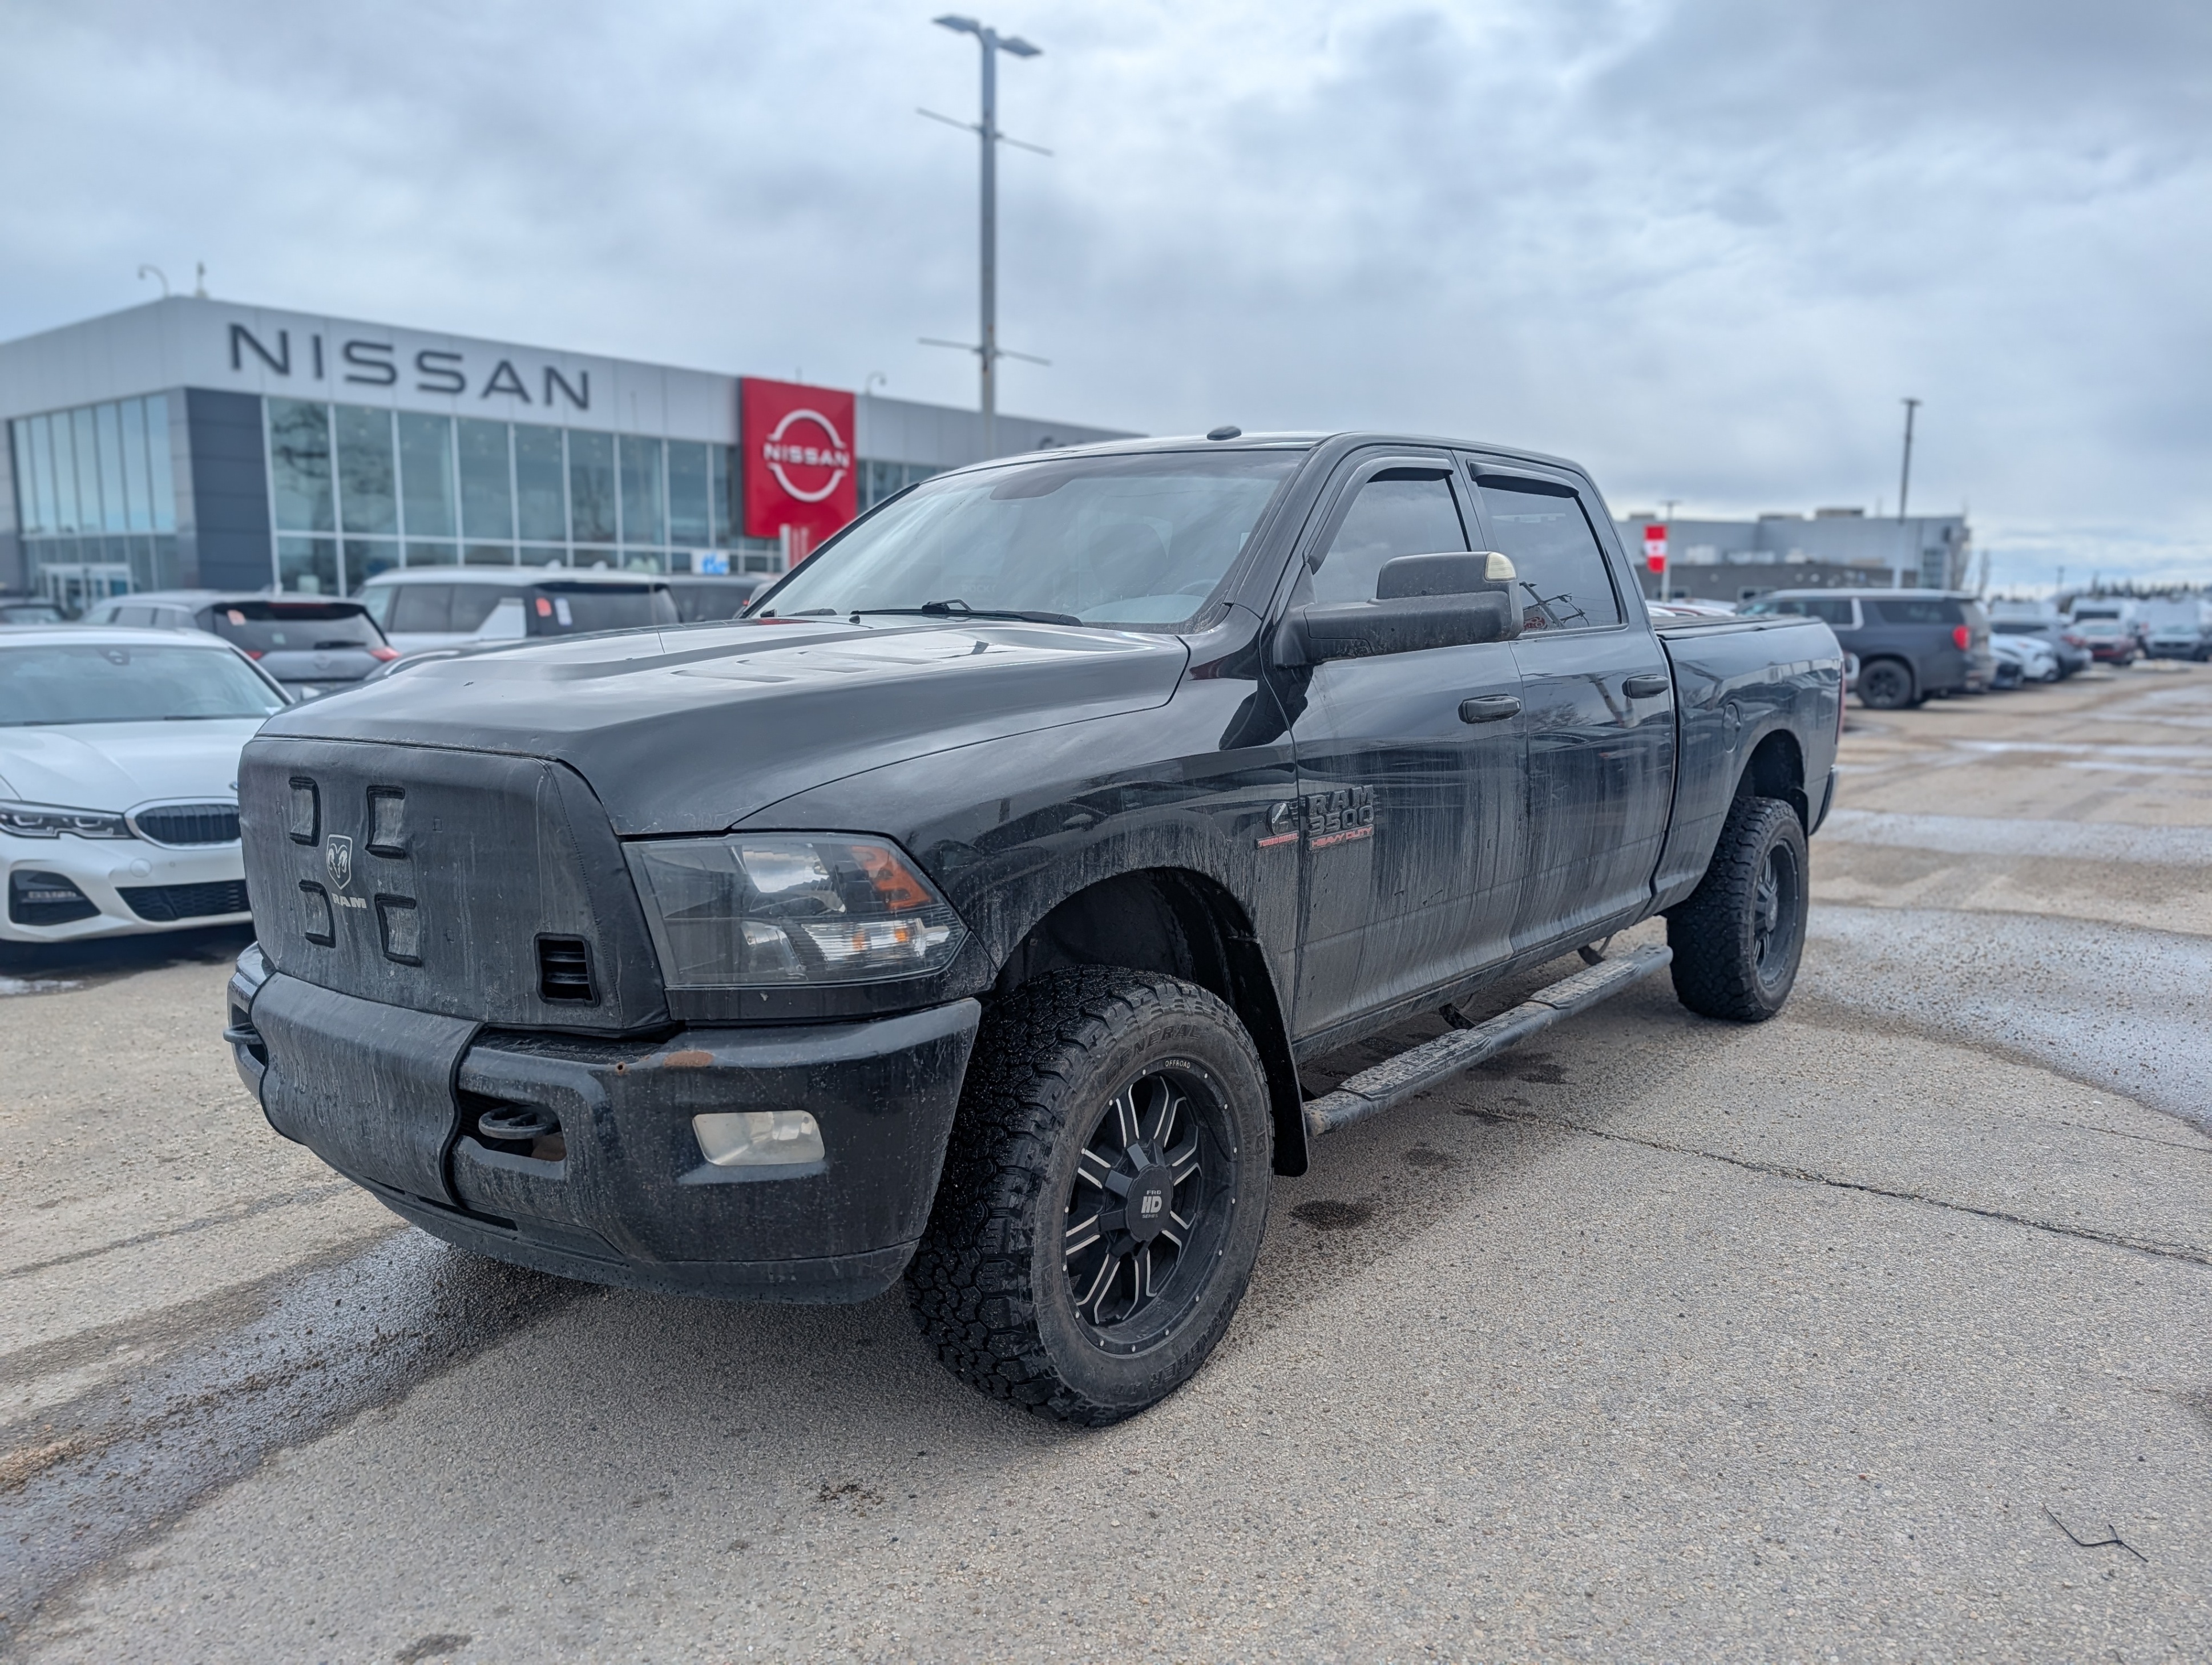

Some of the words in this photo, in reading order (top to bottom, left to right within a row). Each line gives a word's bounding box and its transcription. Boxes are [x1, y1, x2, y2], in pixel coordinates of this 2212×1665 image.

[229, 322, 590, 410] NISSAN
[764, 442, 850, 468] NISSAN
[1307, 784, 1374, 815] RAM
[1308, 805, 1374, 836] 3500
[1312, 832, 1345, 848] HEAVY
[1346, 826, 1372, 839] DUTY
[332, 892, 367, 908] RAM
[1105, 1024, 1200, 1086] GENERAL
[1165, 1060, 1190, 1069] OFFROAD
[1141, 1196, 1162, 1214] HD
